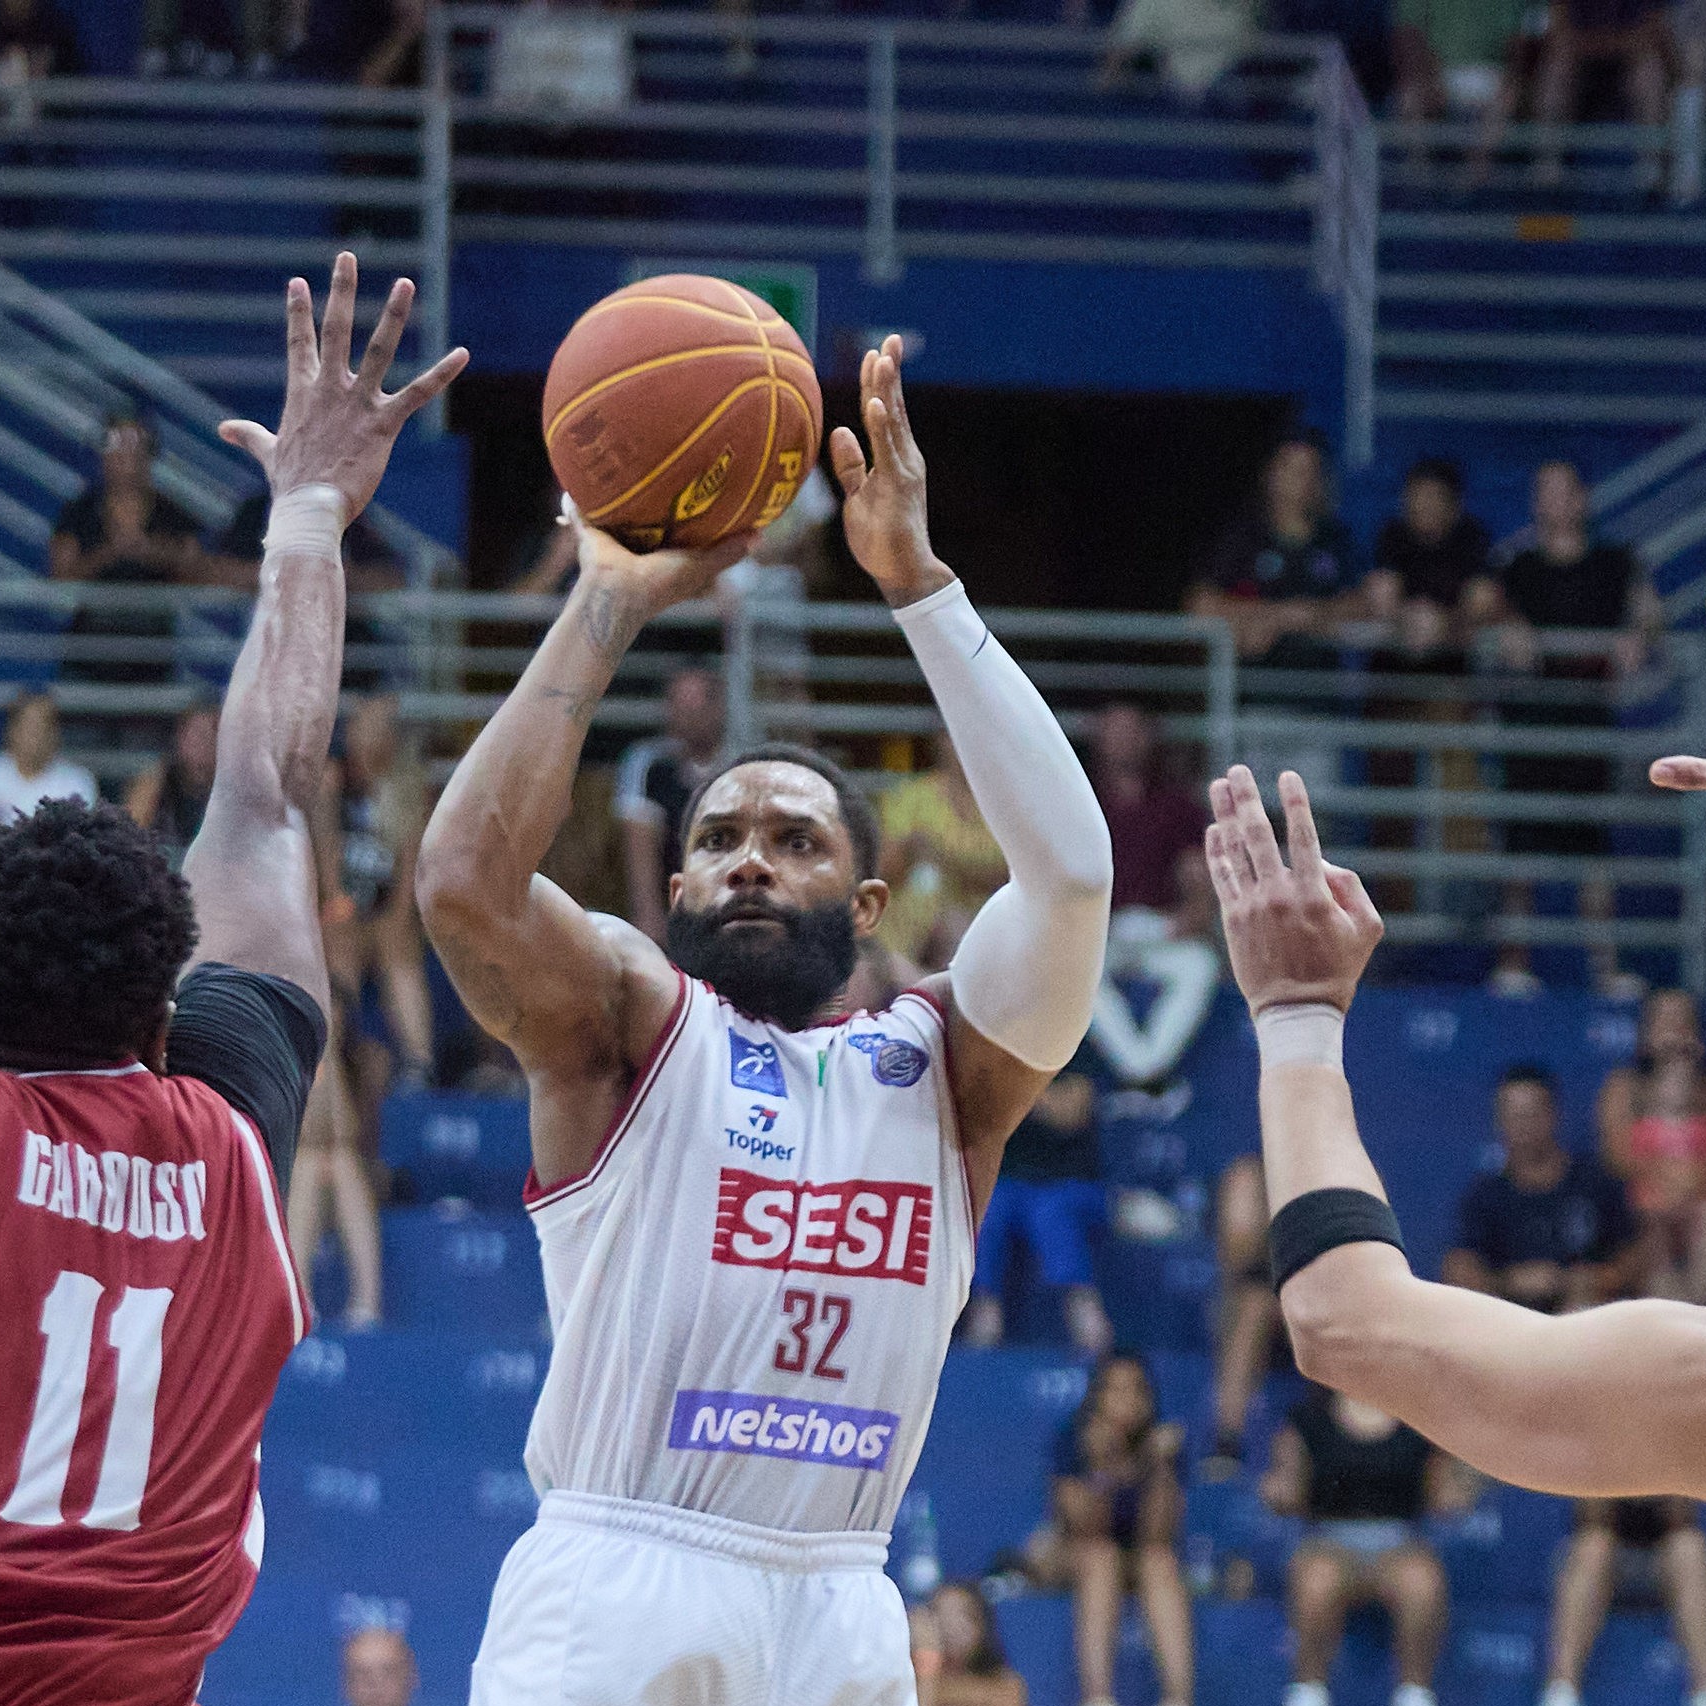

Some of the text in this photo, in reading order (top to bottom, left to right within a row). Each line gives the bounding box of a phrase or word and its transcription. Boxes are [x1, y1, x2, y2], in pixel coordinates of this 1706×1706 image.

[724, 1127, 796, 1161] Topper
[732, 1189, 915, 1270] SESI
[773, 1286, 854, 1382] 32
[0, 1271, 174, 1531] 11
